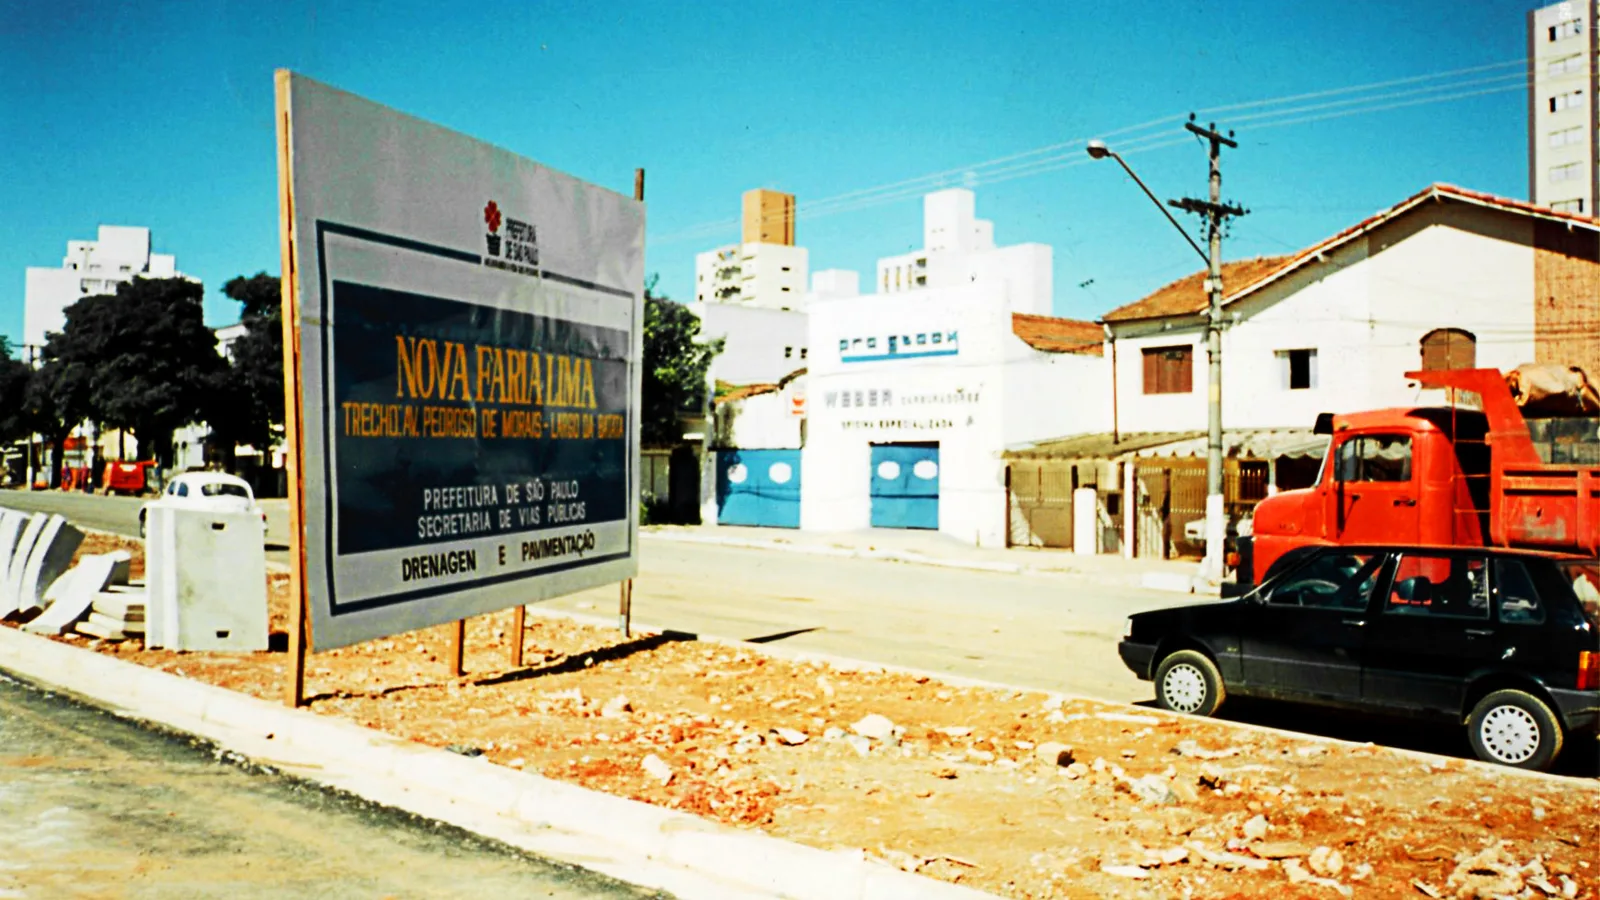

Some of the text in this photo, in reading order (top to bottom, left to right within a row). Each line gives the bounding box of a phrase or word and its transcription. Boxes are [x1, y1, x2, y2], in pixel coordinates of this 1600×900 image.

[396, 335, 598, 409] NOVA FARIA LIMA
[423, 405, 477, 438] PEDROSO
[482, 408, 498, 438] DE
[502, 410, 542, 439] MORAIS
[423, 477, 579, 511] PREFEITURA DE SÃO PAULO
[417, 509, 492, 539] SECRETARIA
[499, 508, 511, 529] DE
[518, 505, 541, 527] VIAS
[402, 528, 595, 582] DRENAGEN E PAVIMENTAÇÃO
